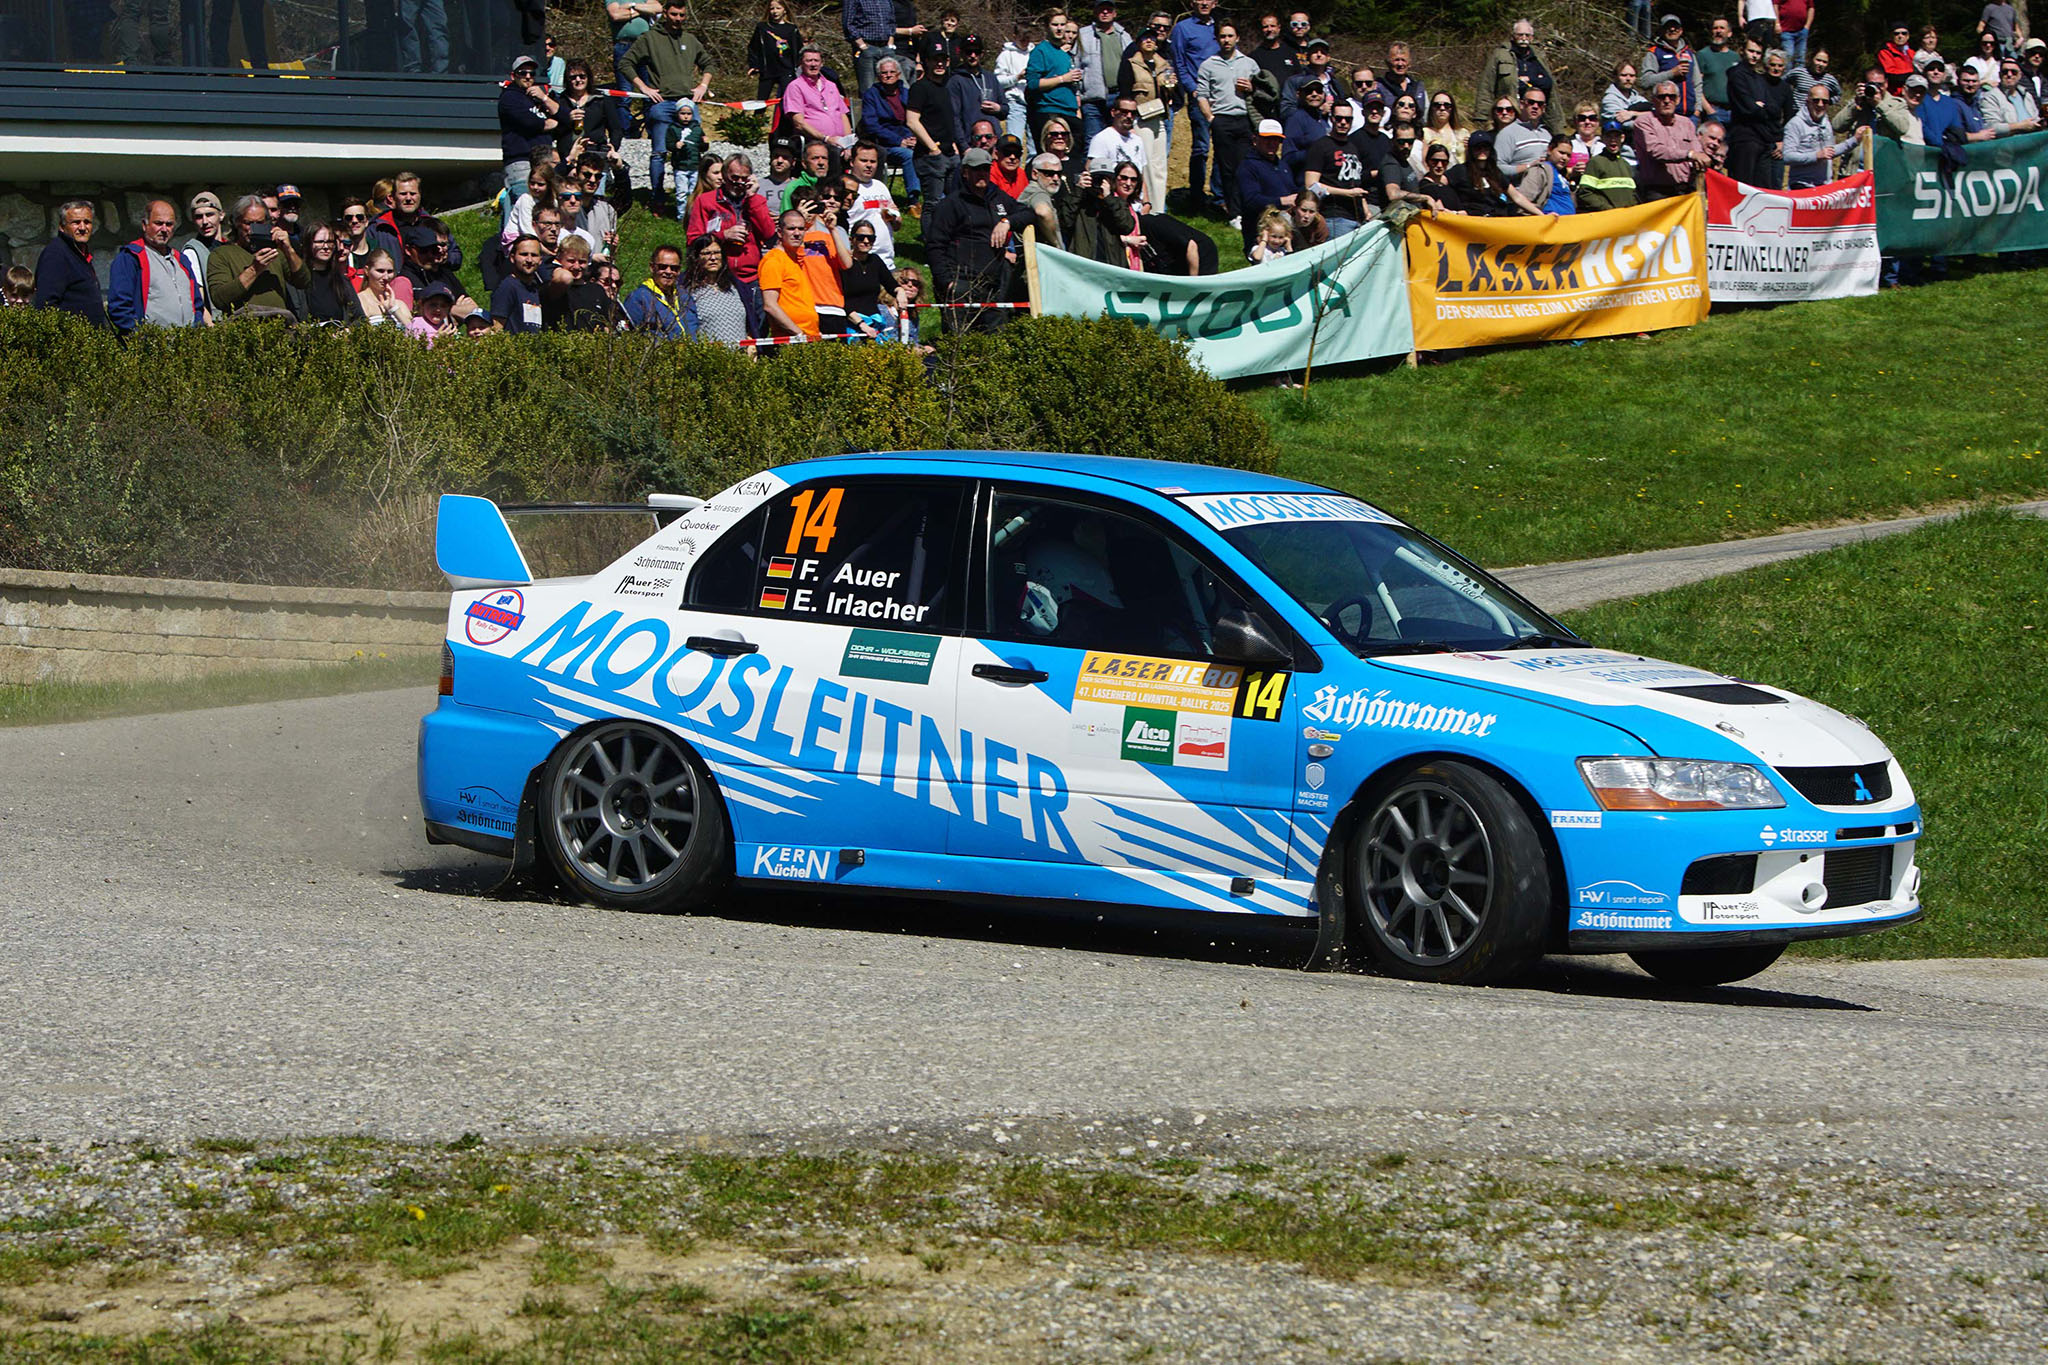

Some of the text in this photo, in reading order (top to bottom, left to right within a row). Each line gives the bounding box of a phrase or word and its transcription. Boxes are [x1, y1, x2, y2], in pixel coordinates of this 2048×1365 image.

[1436, 225, 1693, 293] LASERHERO
[1708, 244, 1809, 273] STEINKELLNER
[1436, 304, 1462, 320] DER
[1462, 301, 1514, 318] SCHNELLE
[1514, 301, 1540, 317] WEG
[1540, 299, 1564, 316] ZUM
[713, 504, 743, 513] strasser
[680, 518, 721, 531] Quooker
[785, 488, 845, 554] 14
[628, 576, 652, 588] Auer
[799, 559, 900, 588] F. Auer
[469, 603, 520, 628] MITROPA
[792, 588, 930, 623] E. Irlacher
[850, 644, 875, 653] DOHR
[881, 647, 931, 659] WOLFSBERG
[1085, 656, 1239, 689] LASERHERO
[1078, 687, 1230, 712] 47. LASERHERO LAVANTTAL-RALLYE 2025
[1243, 671, 1287, 720] 14
[1302, 684, 1498, 738] Schönramer
[511, 601, 1086, 861] MOOSLEITNER
[1298, 799, 1328, 808] MACHER
[1299, 791, 1329, 800] MEISTER
[1552, 814, 1600, 825] FRANKE
[1780, 827, 1829, 843] strasser
[752, 845, 831, 880] KERN
[1613, 896, 1637, 904] smart
[1639, 896, 1664, 904] repair
[1711, 902, 1739, 910] Auer
[1576, 911, 1673, 929] Schönramer
